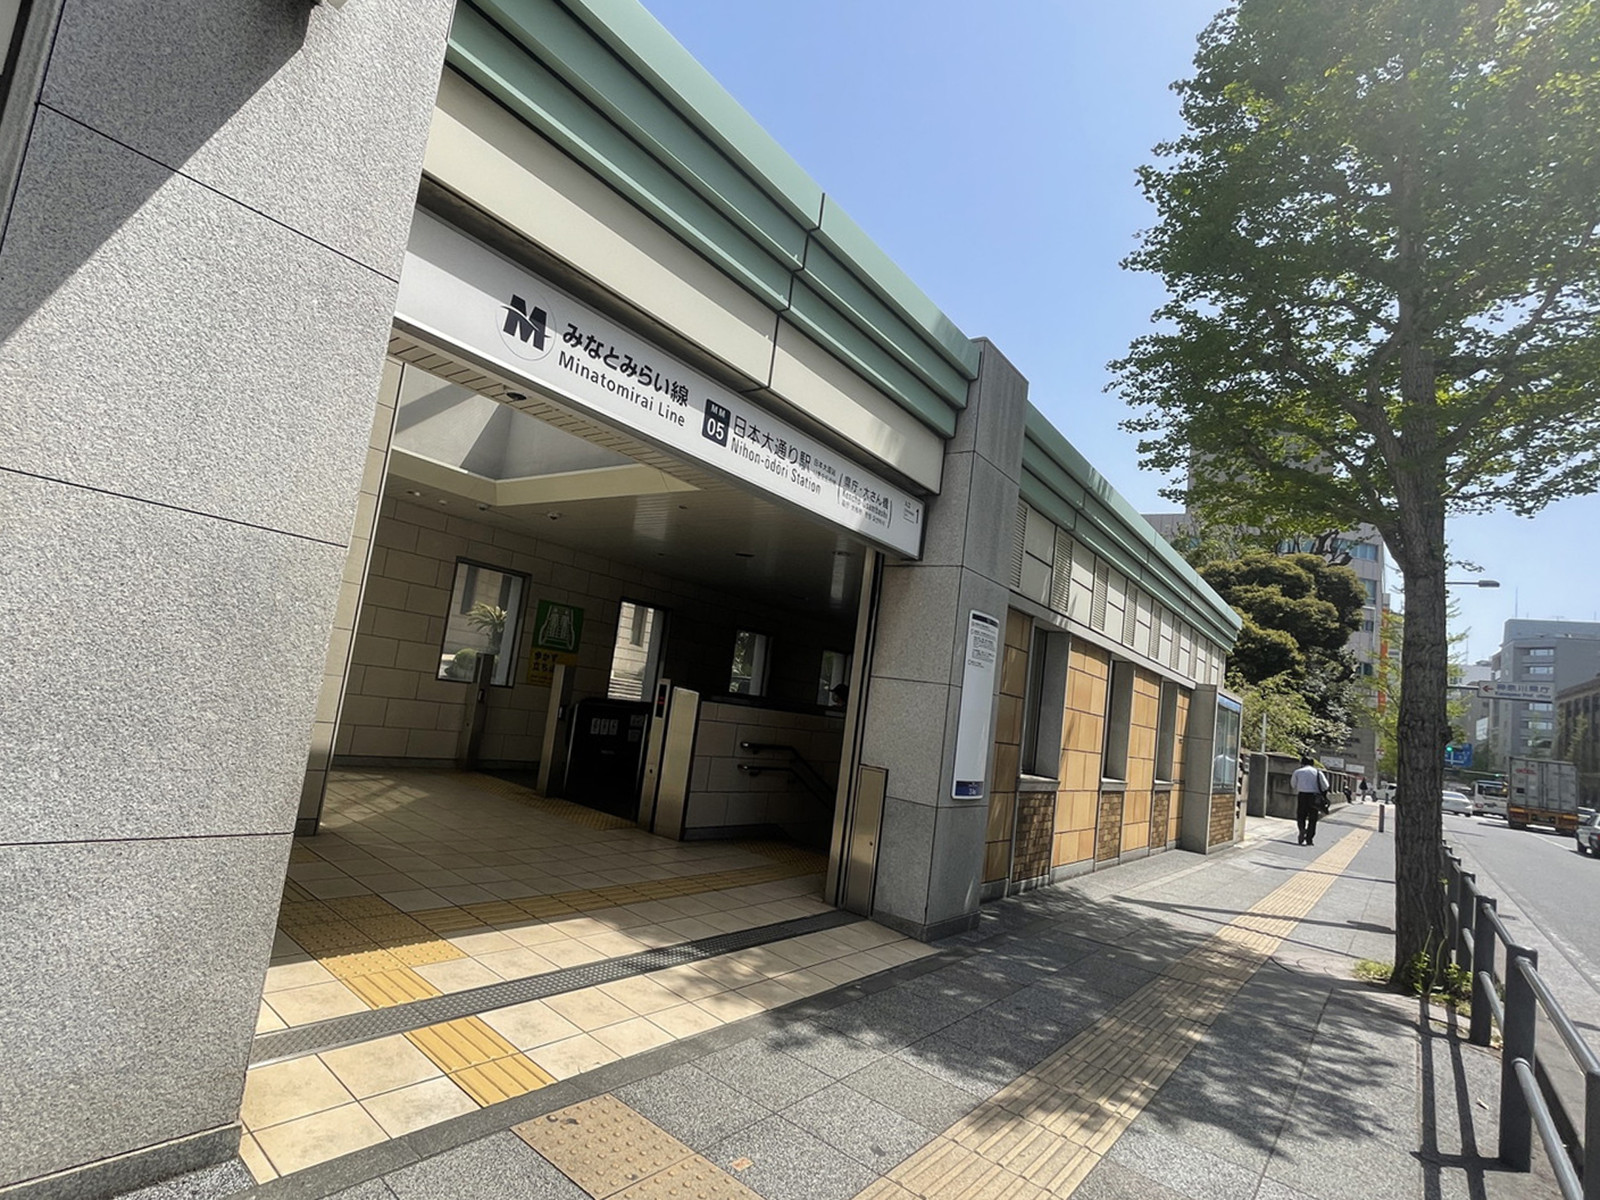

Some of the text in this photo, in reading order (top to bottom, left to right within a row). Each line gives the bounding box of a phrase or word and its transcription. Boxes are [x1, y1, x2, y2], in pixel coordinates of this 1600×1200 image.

[557, 350, 686, 428] Minatomirai Line
[562, 323, 690, 408] みなとみらい線
[706, 417, 725, 441] 05
[733, 414, 812, 473] 日本大通り駅
[790, 467, 822, 496] Station
